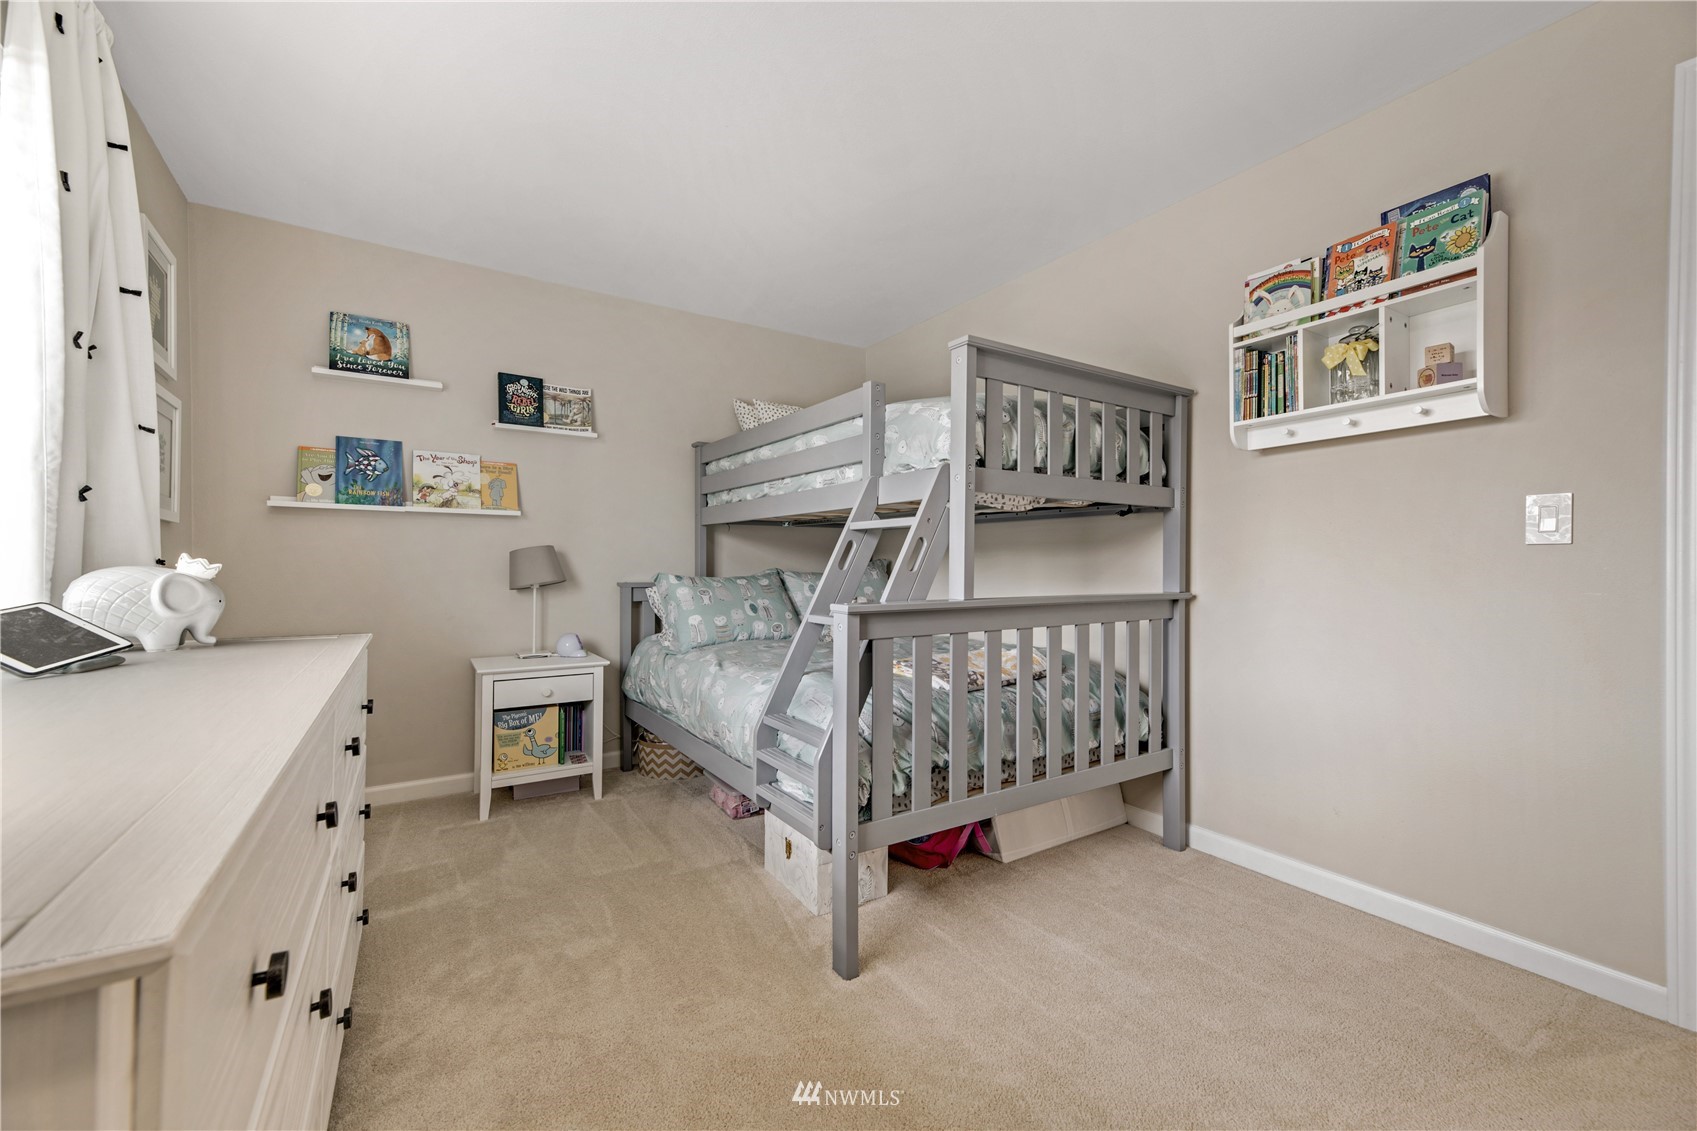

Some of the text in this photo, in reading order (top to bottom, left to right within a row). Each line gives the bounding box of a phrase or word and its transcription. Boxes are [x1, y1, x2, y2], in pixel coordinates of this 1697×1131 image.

[1412, 223, 1439, 237] Pete
[1450, 209, 1474, 224] Cat
[1335, 253, 1356, 264] Pete
[1365, 238, 1390, 253] Cat's
[336, 353, 406, 371] I've Loved You
[336, 360, 363, 370] Since
[365, 365, 403, 376] Forever
[511, 394, 535, 407] REBEL
[507, 403, 537, 416] GIRLS
[416, 454, 430, 462] The
[430, 453, 445, 463] Year
[457, 455, 478, 467] Sheep
[348, 489, 376, 497] RAINBOW
[497, 712, 543, 729] Big Box of ME!
[511, 710, 528, 720] Pigeon's
